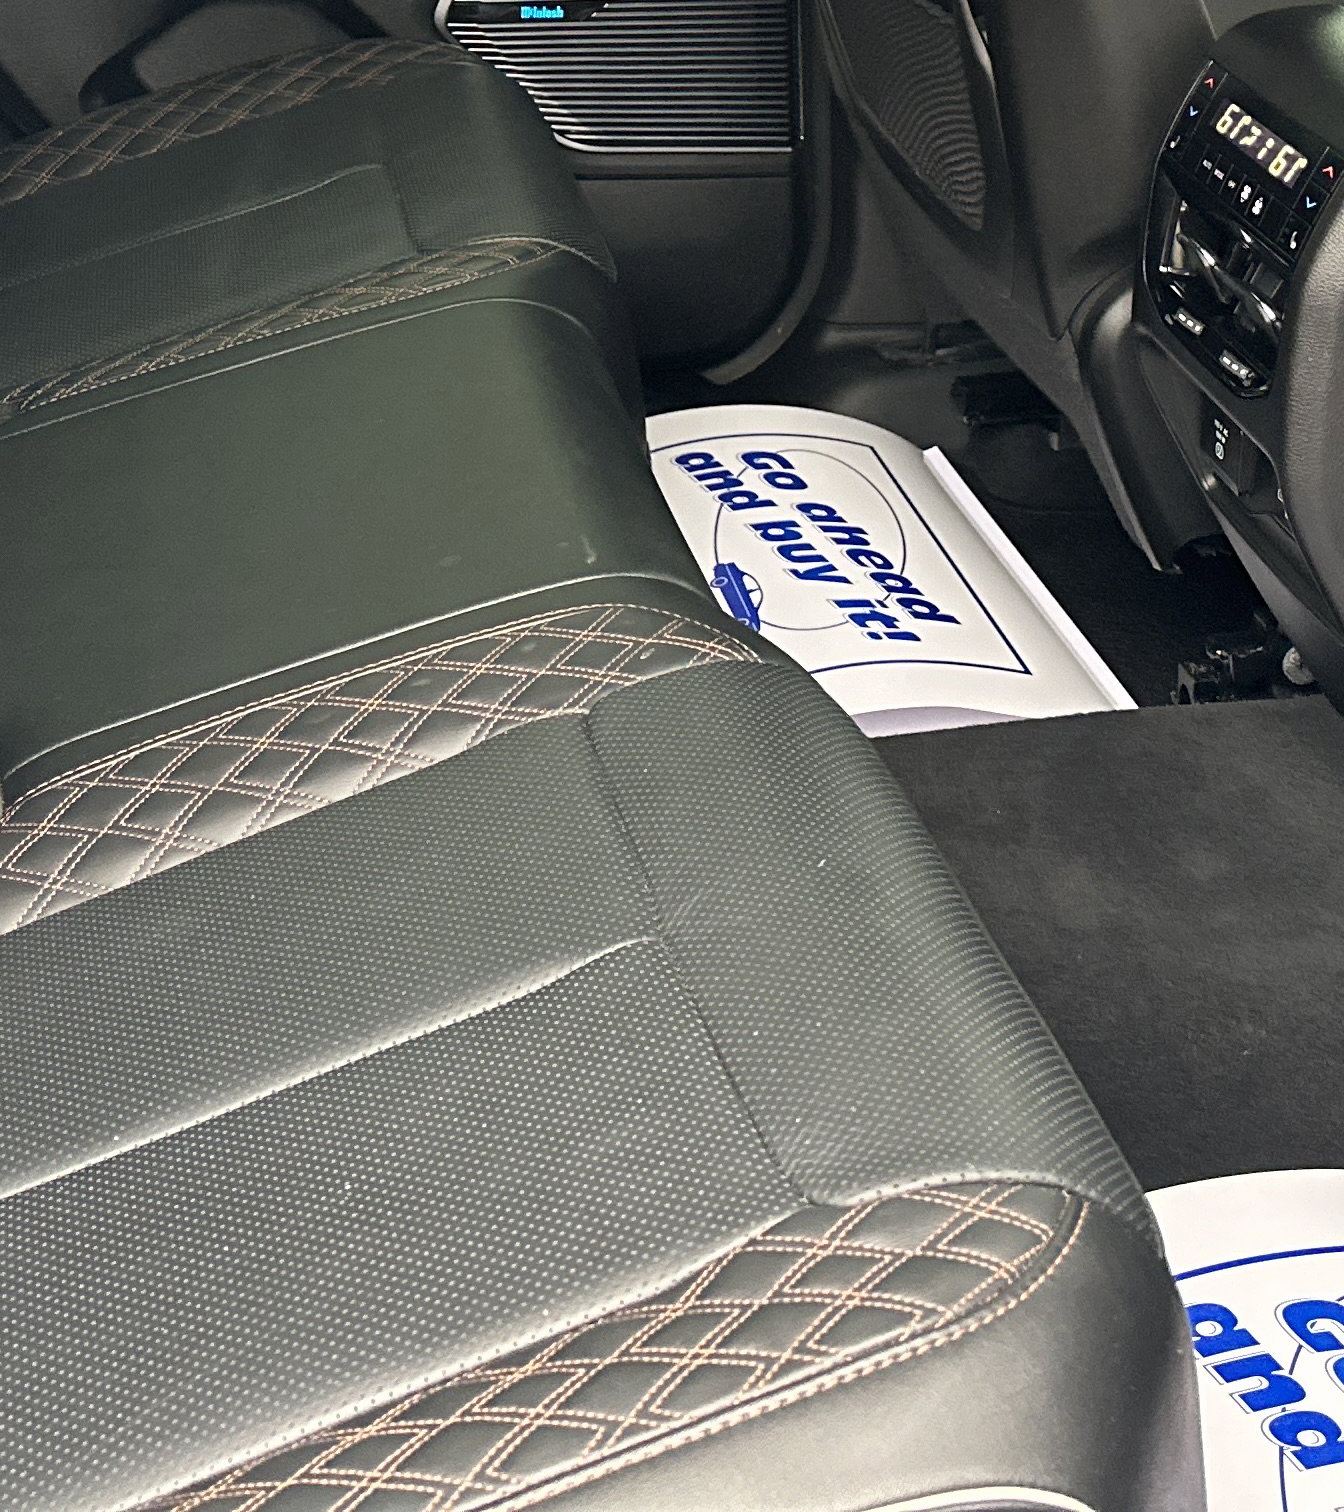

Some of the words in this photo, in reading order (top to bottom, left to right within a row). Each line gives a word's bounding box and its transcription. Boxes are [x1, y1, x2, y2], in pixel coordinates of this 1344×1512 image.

[671, 451, 778, 513] and
[748, 519, 853, 586] buy
[827, 599, 922, 643] it!
[739, 451, 808, 492] Go
[795, 502, 963, 626] ahead
